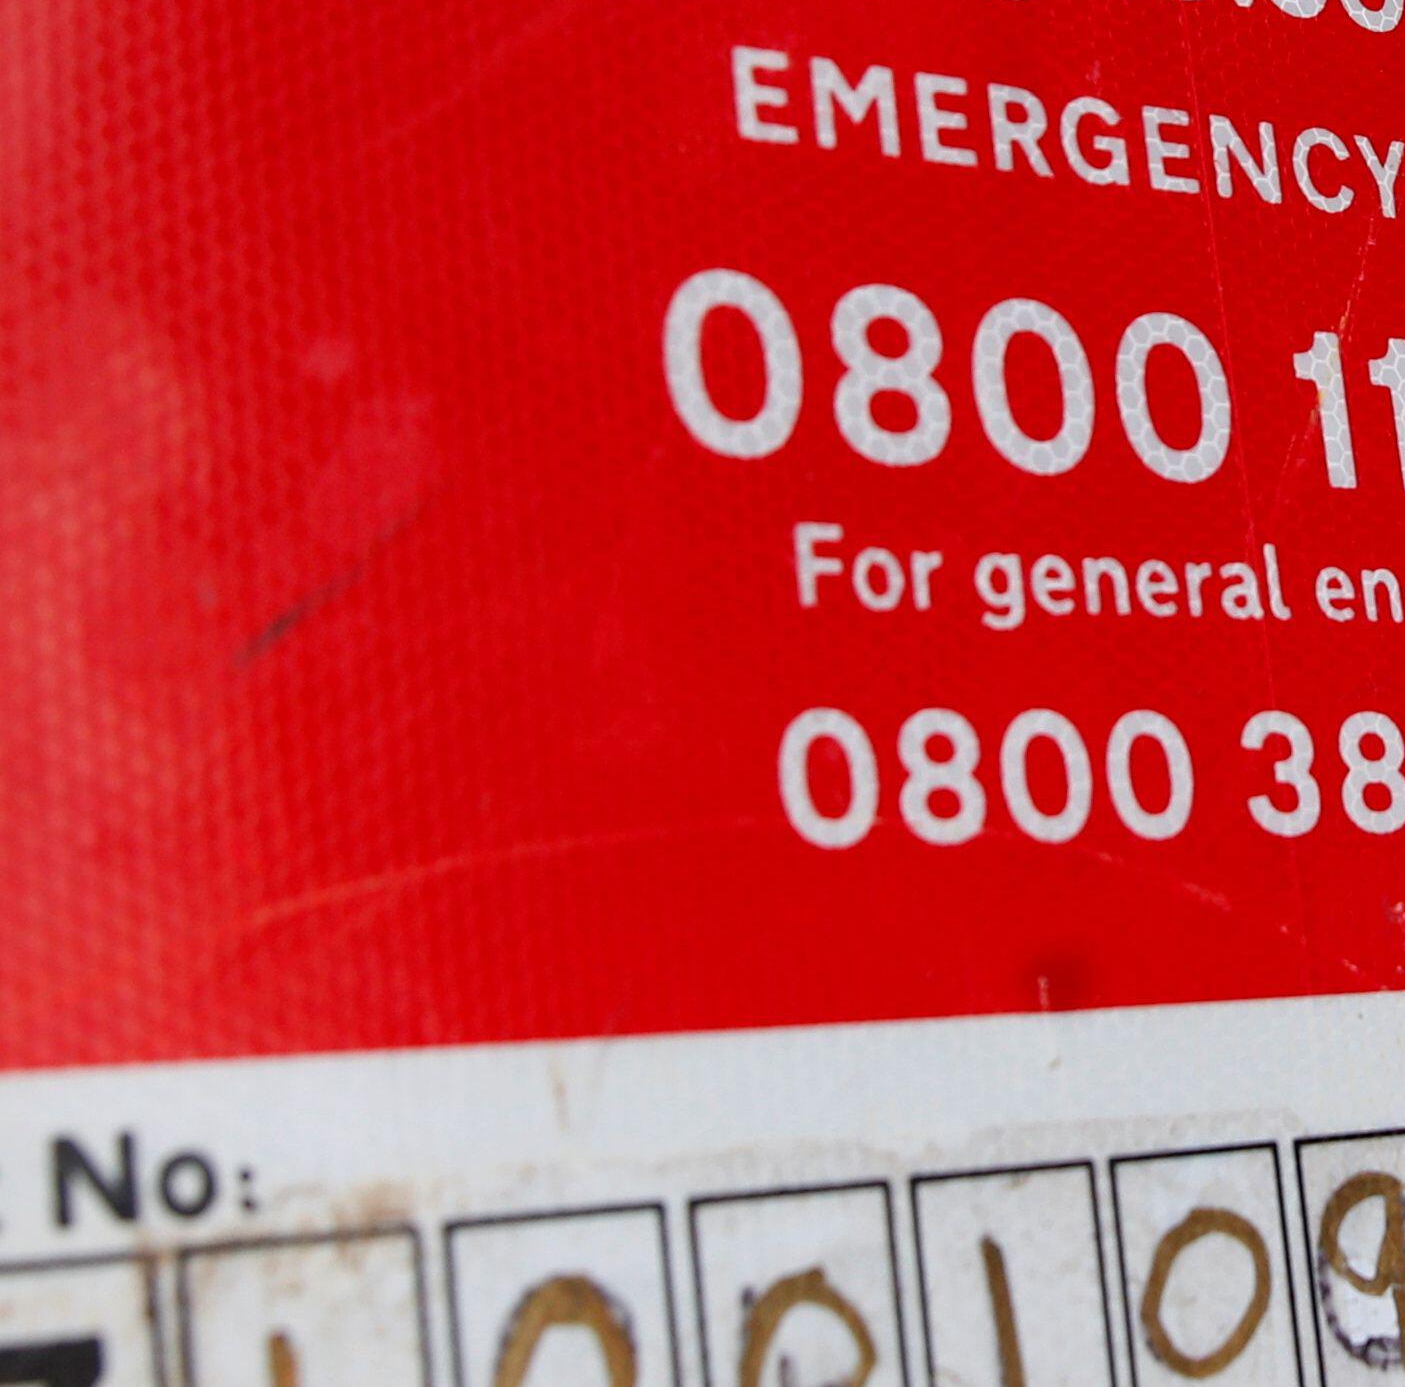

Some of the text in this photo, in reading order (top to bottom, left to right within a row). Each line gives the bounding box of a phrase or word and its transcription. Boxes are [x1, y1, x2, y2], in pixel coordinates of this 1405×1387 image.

[733, 47, 1405, 220] EMERGENCY
[664, 268, 1232, 484] 0800
[796, 522, 942, 609] For
[975, 543, 1291, 630] general
[780, 708, 1194, 847] 0800
[53, 1128, 256, 1229] No:
